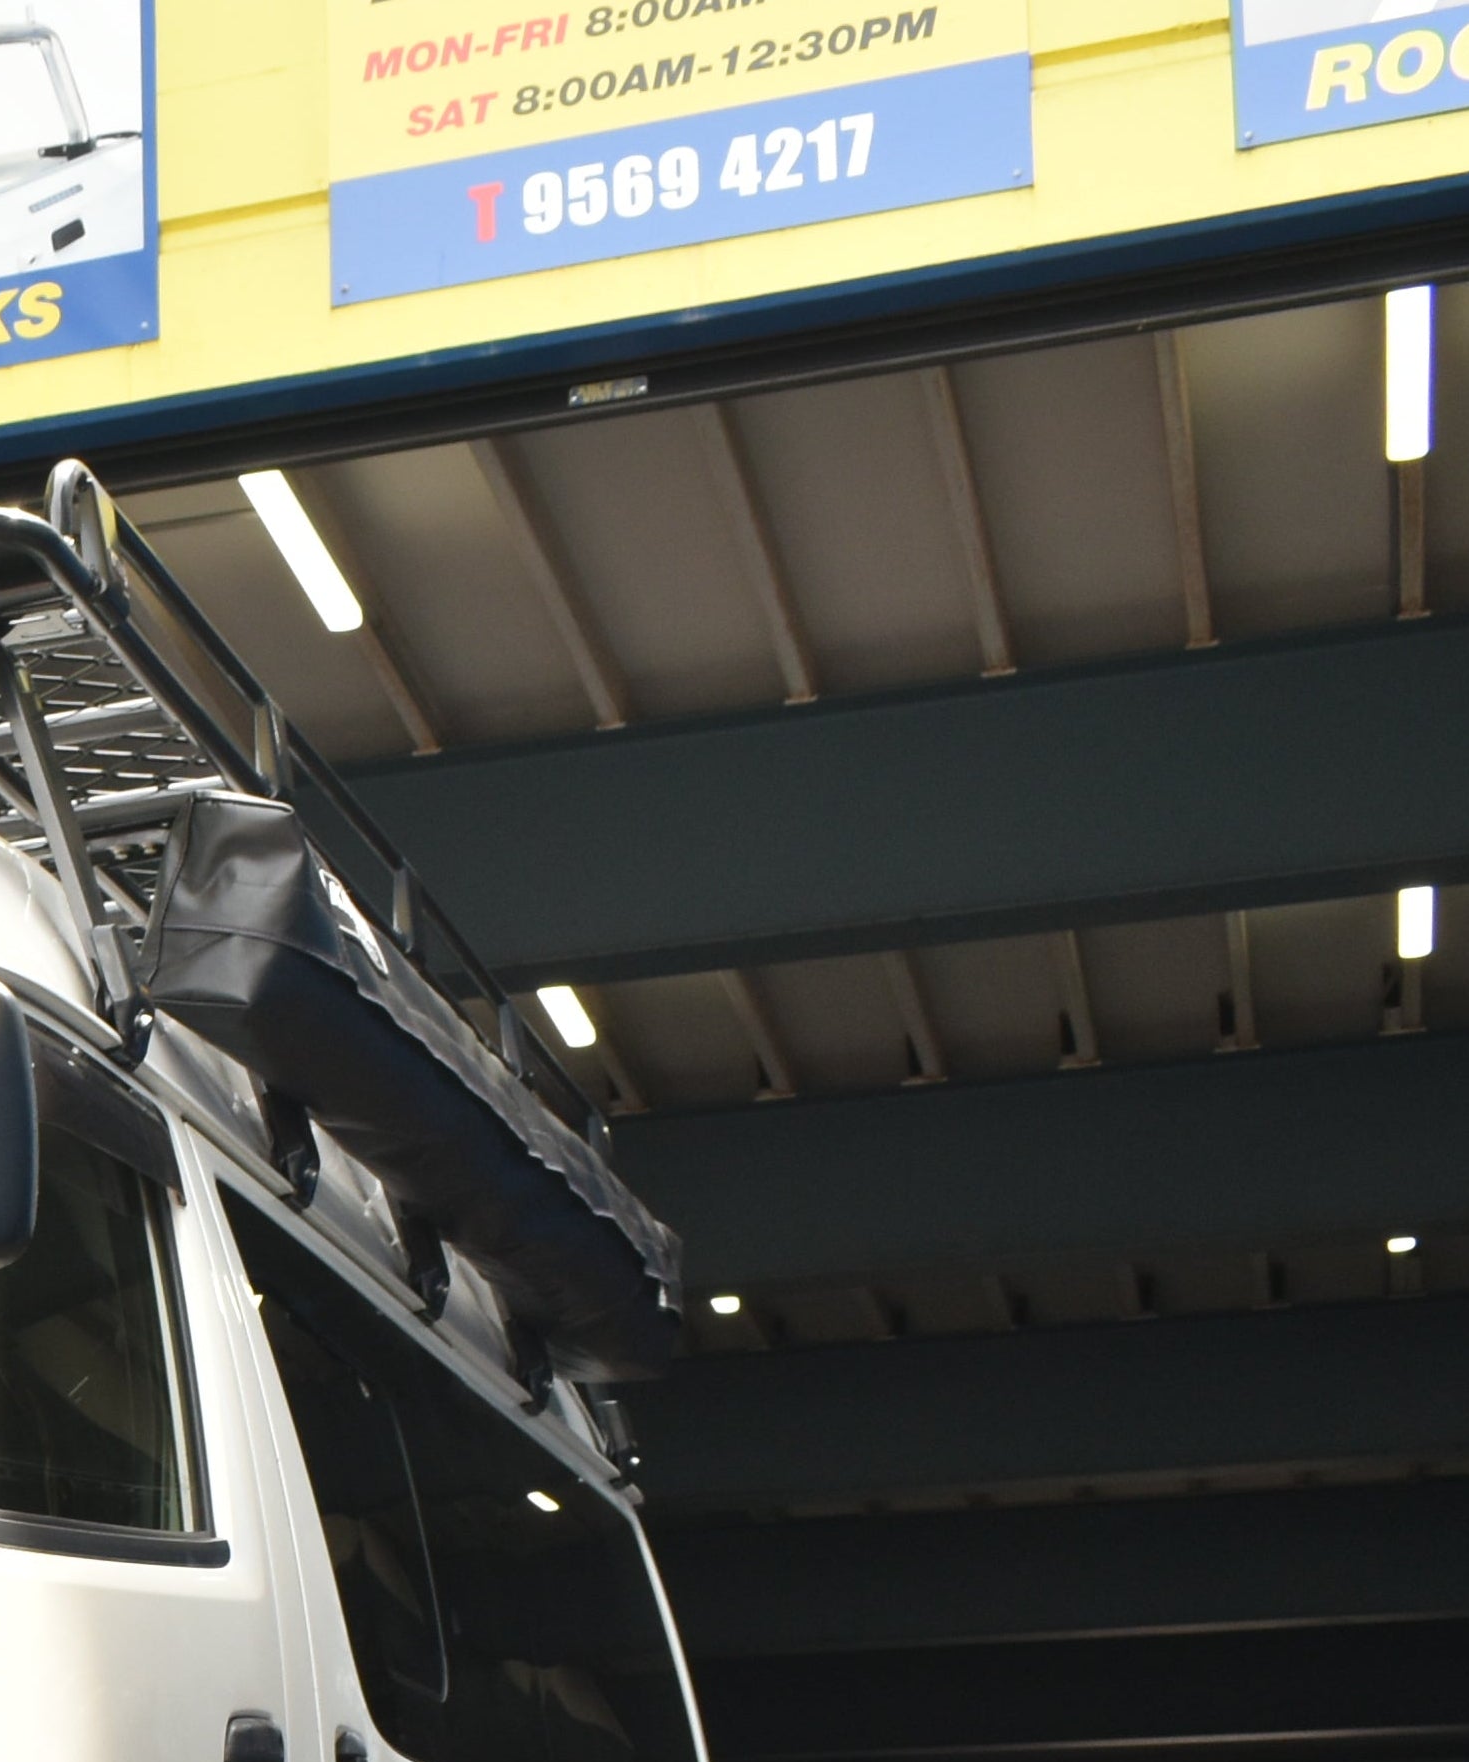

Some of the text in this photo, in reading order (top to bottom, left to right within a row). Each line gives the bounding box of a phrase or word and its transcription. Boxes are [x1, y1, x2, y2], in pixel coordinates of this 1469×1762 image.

[363, 13, 570, 83] MON-FRI
[406, 6, 938, 137] SAT 8:00AM-12:30PM
[467, 112, 875, 243] T 9569 4217
